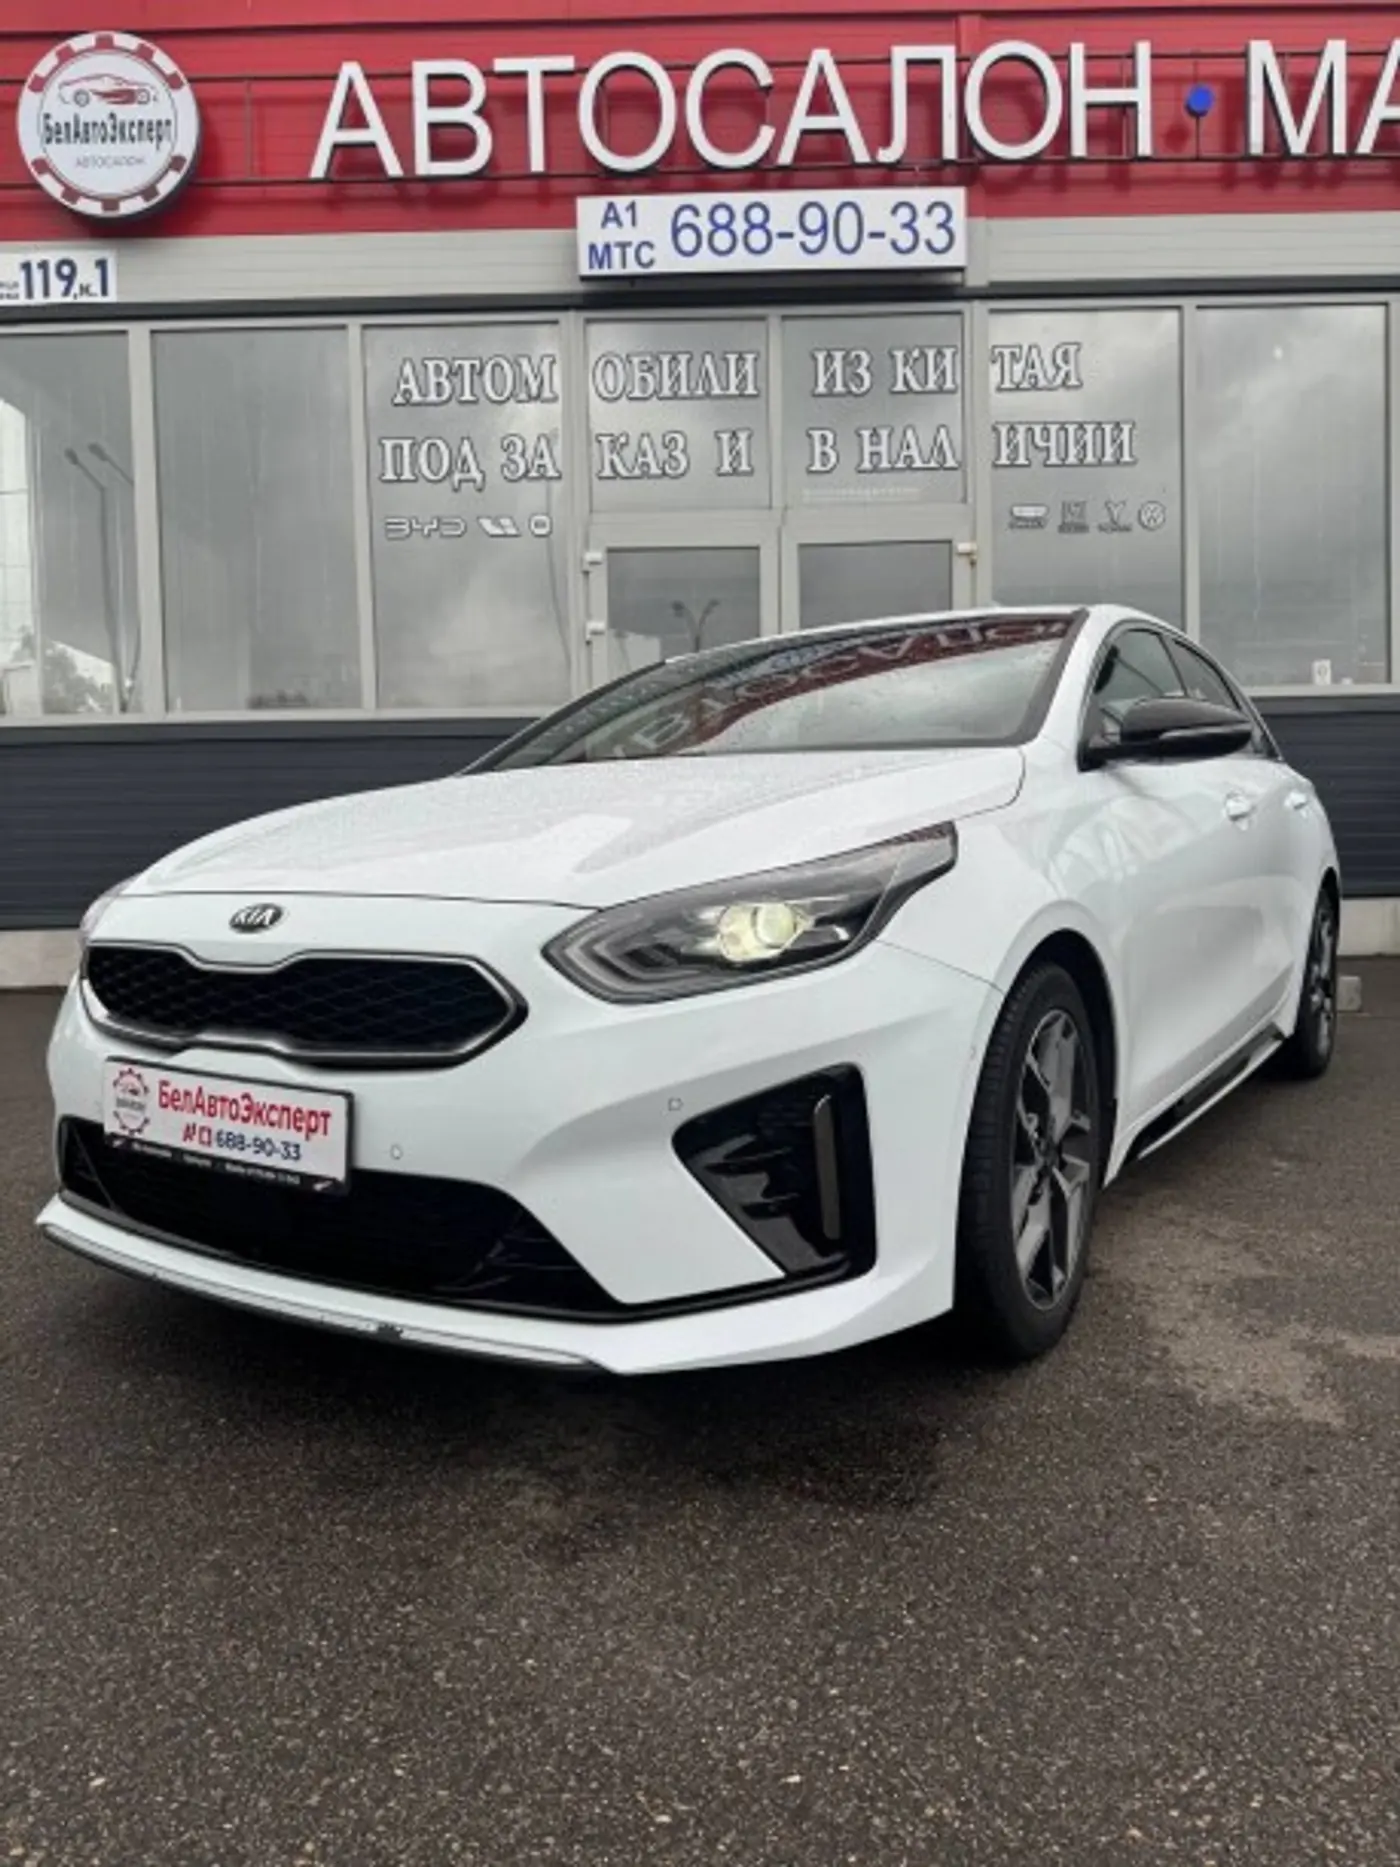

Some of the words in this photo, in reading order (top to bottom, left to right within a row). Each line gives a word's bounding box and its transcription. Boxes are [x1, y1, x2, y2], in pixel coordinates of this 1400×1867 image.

[43, 112, 172, 151] БелАвтоЭксперт
[309, 40, 1153, 179] АВТОСАЛОН
[600, 200, 638, 230] А1
[671, 200, 956, 258] 688-90-33
[588, 241, 656, 270] МТС
[811, 348, 873, 397] ИЗ
[379, 435, 486, 492] ПОД
[715, 428, 753, 476] И
[806, 427, 839, 474] В
[385, 515, 467, 541] BYD
[158, 1079, 332, 1140] БелАвтоЭксперт
[216, 1129, 302, 1161] 688-90-33
